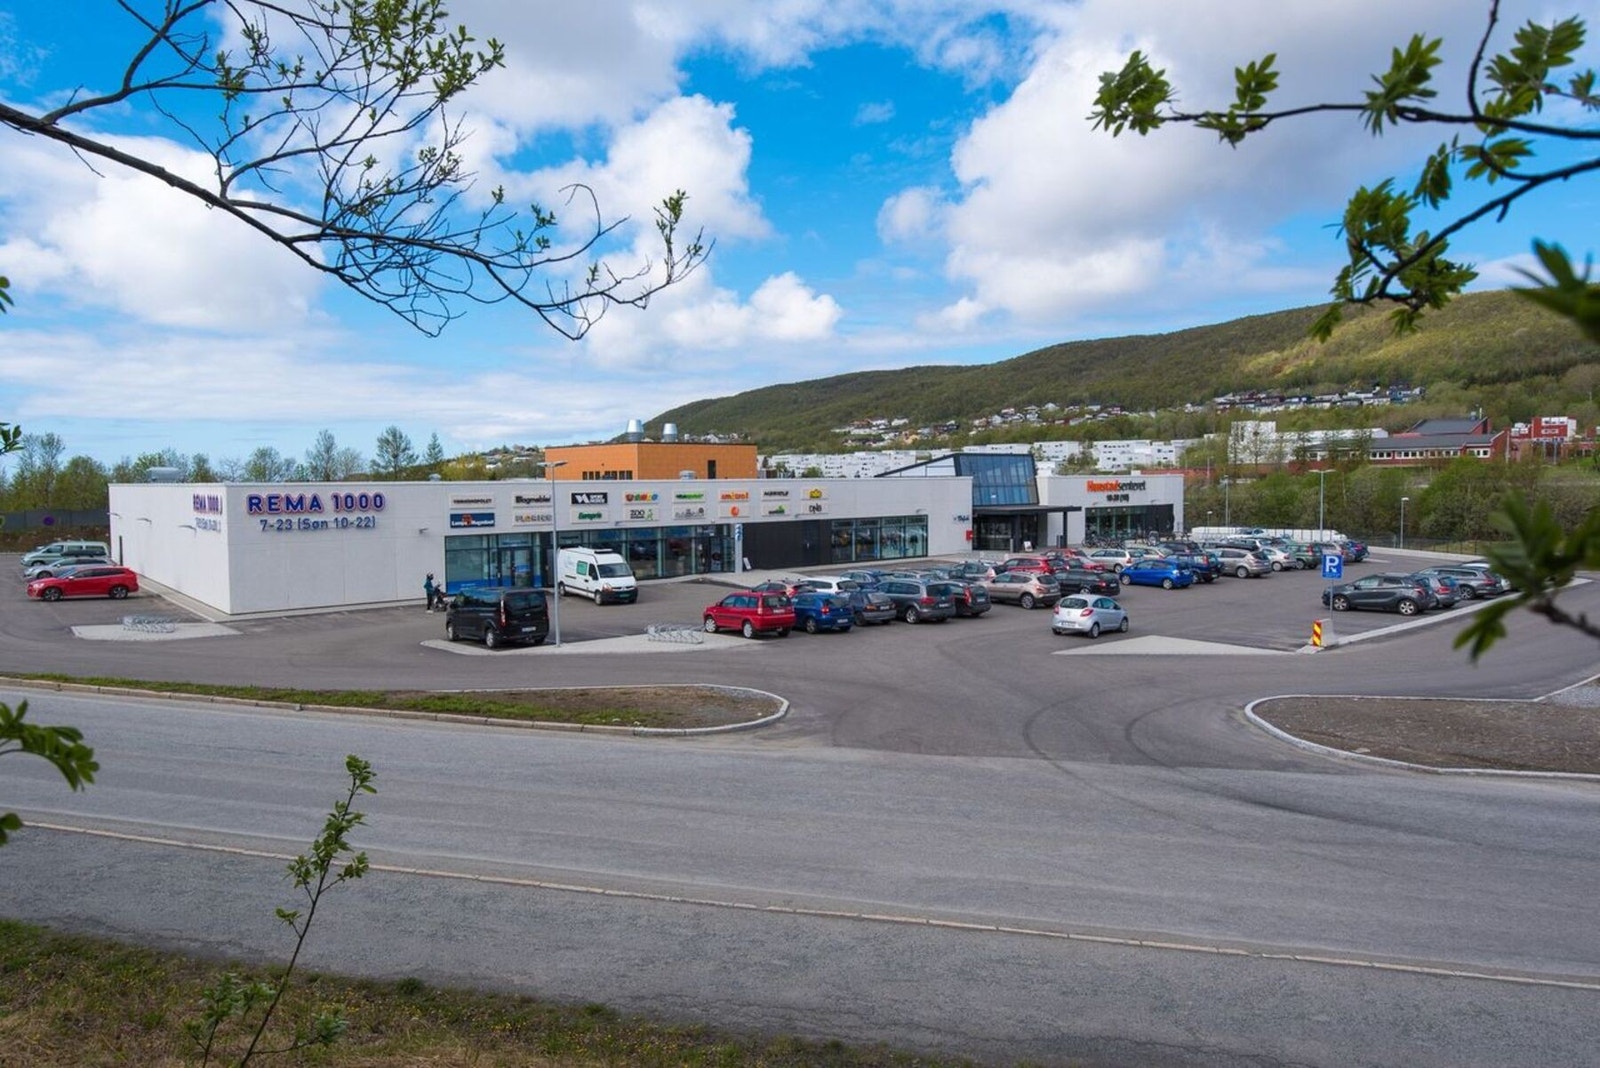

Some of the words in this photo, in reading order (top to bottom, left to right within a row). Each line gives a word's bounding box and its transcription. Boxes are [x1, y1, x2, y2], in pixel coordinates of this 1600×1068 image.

[247, 495, 324, 514] REMA
[331, 493, 385, 512] 1000
[260, 518, 293, 531] 7-23
[334, 515, 376, 529] 10-22)
[1325, 555, 1340, 573] P
